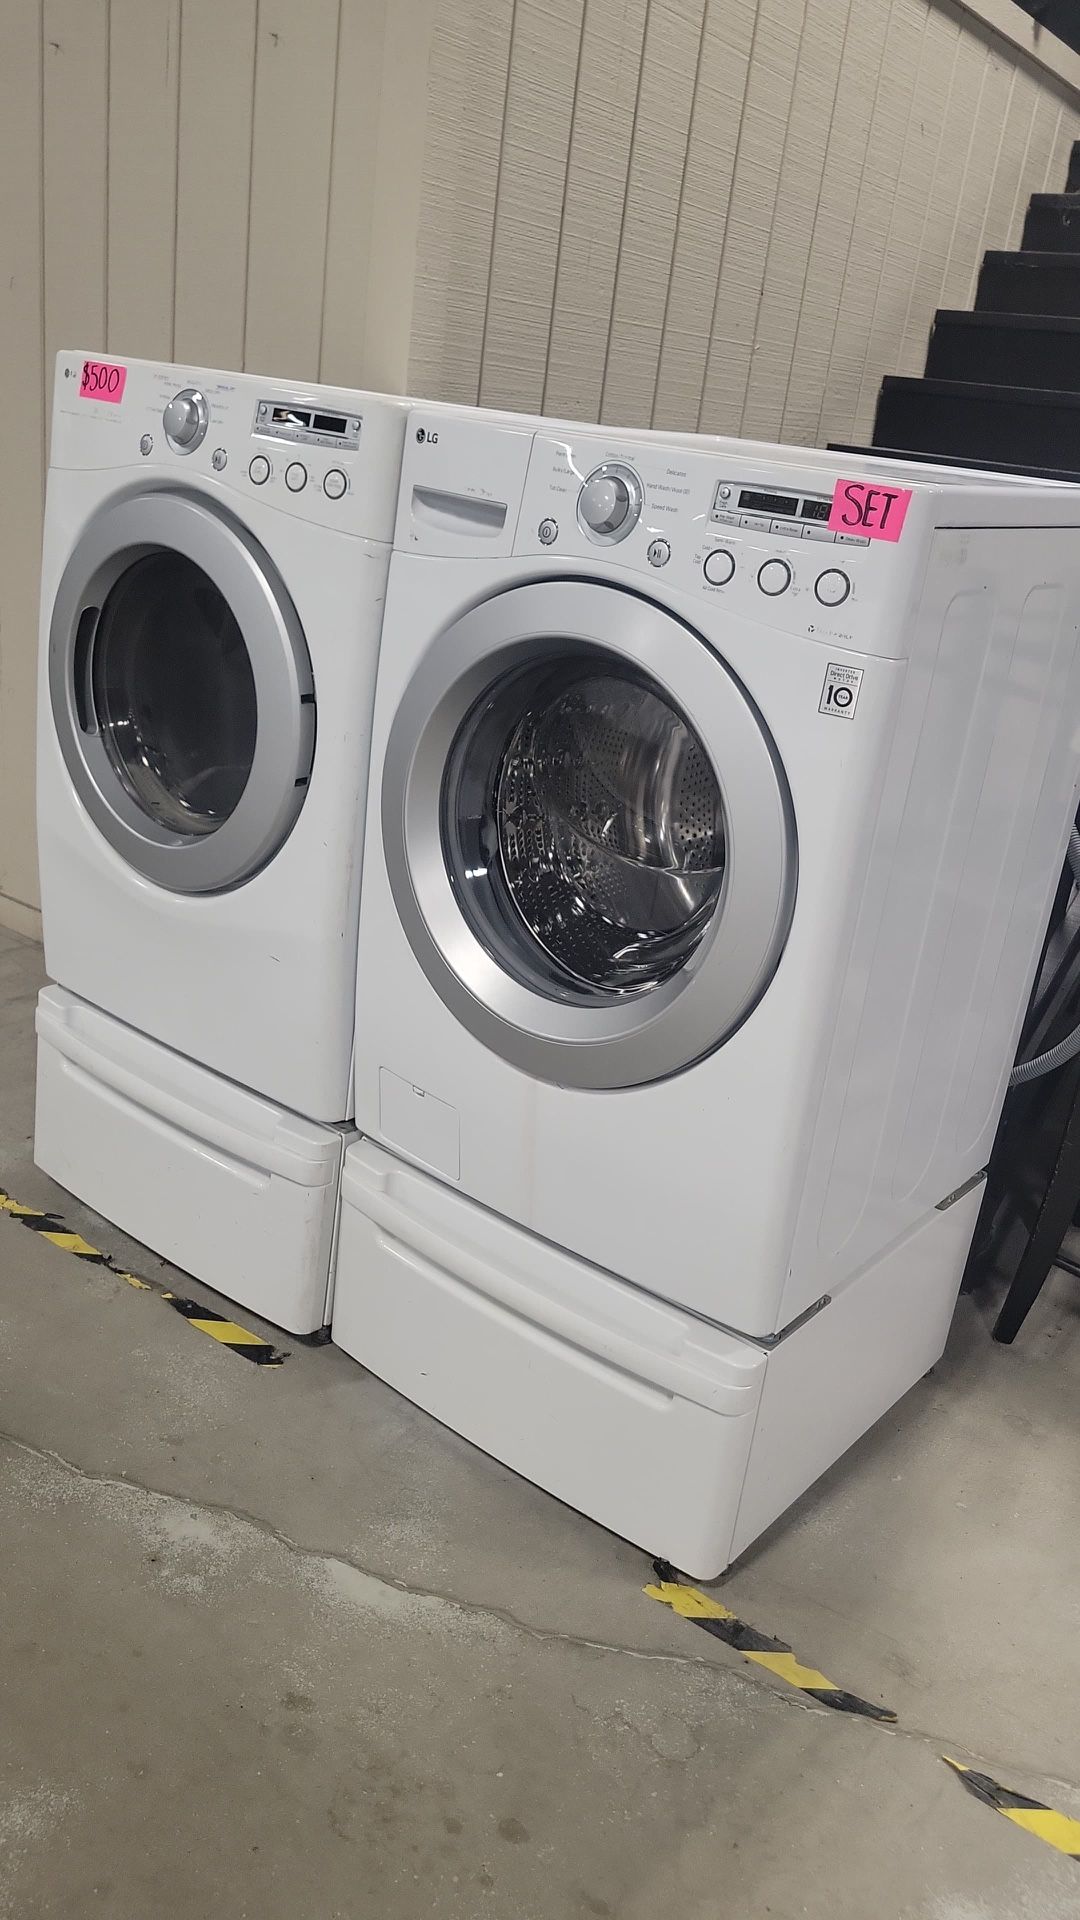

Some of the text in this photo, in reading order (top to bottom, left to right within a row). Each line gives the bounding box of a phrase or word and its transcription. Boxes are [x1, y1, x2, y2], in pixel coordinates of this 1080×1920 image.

[82, 361, 120, 392] $500
[426, 432, 439, 444] LG
[651, 503, 679, 513] Speed Wash
[842, 484, 898, 529] SET
[830, 670, 845, 679] Direct
[826, 685, 853, 707] 10
